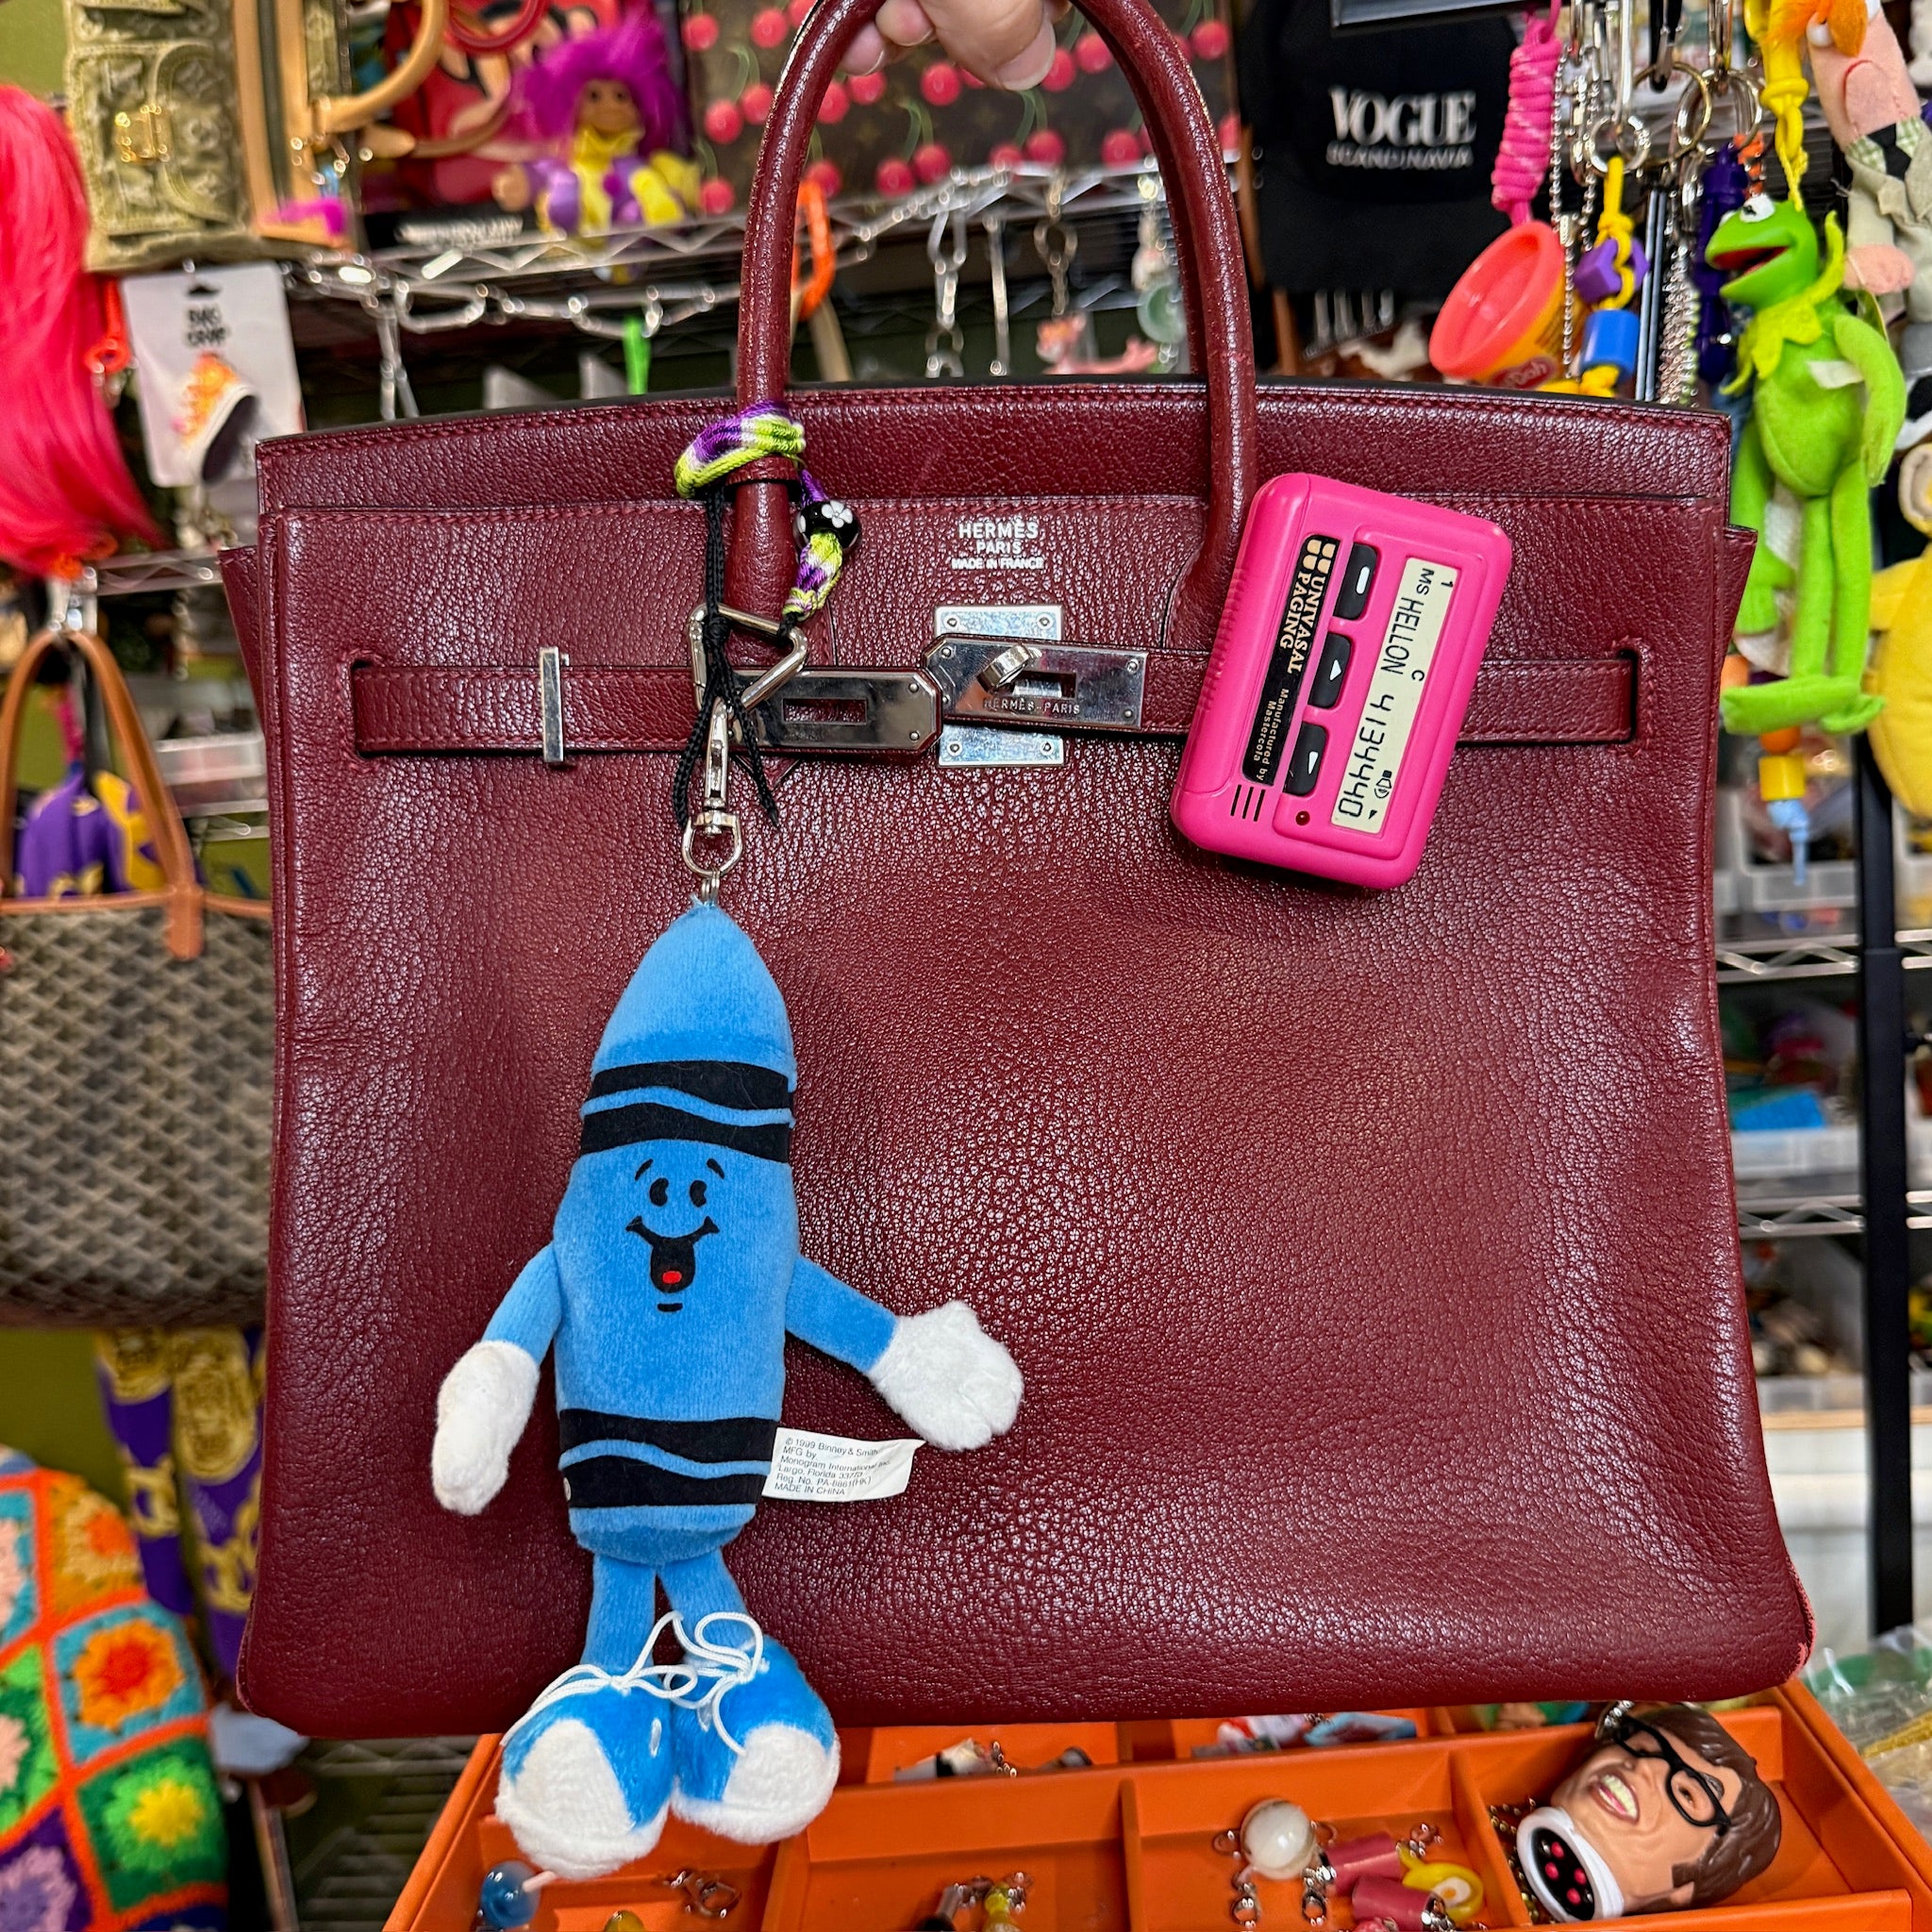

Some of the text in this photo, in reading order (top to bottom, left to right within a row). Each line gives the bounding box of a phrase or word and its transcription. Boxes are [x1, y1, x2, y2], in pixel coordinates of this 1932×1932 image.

[1328, 85, 1477, 147] VOGUE
[958, 516, 1039, 539] HERMÈS
[976, 541, 1023, 555] PARIS
[951, 557, 1044, 570] MADE IN FRANCE
[1279, 571, 1312, 650] PAGING
[1287, 575, 1326, 675] UNIVASAL
[1410, 580, 1454, 682] 1 C
[1338, 567, 1436, 818] MS HELLON 4134440
[1256, 688, 1290, 781] Manufactured by
[783, 1444, 817, 1460] MFG by
[795, 1438, 816, 1449] 1999
[818, 1441, 847, 1456] Binney
[847, 1447, 854, 1456] &
[780, 1455, 826, 1469] Monogram
[808, 1468, 836, 1478] Florida
[774, 1482, 802, 1492] MADE
[816, 1486, 845, 1495] CHINA
